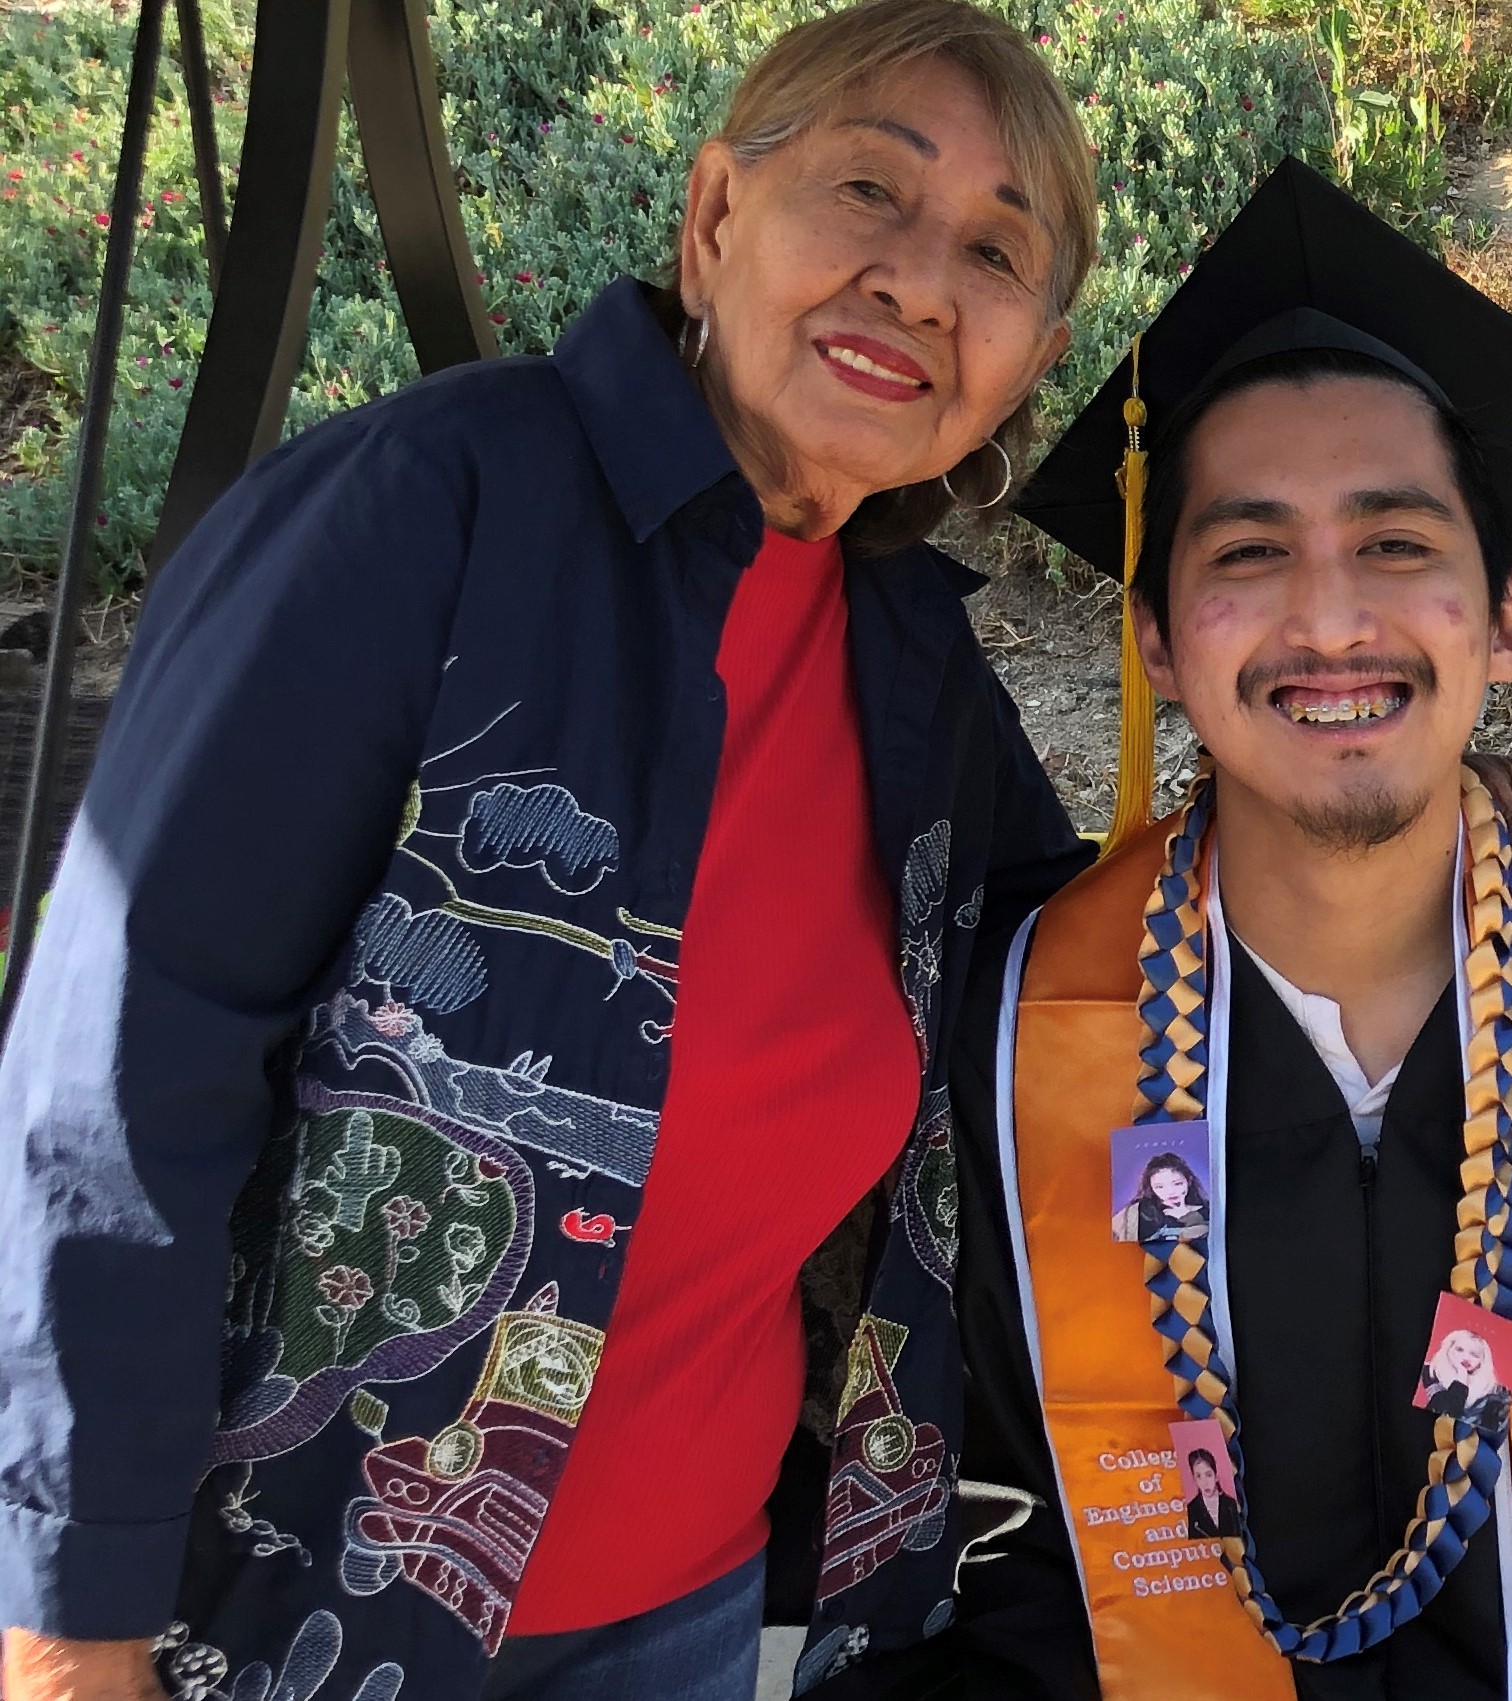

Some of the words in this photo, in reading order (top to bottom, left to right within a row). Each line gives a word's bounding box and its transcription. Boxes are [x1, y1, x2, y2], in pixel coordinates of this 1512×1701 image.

[1099, 1449, 1178, 1471] Colleg
[1139, 1473, 1163, 1493] of
[1084, 1498, 1188, 1526] Enginee
[1145, 1519, 1189, 1543] and
[1113, 1542, 1223, 1570] Compute
[1133, 1570, 1229, 1597] Science
